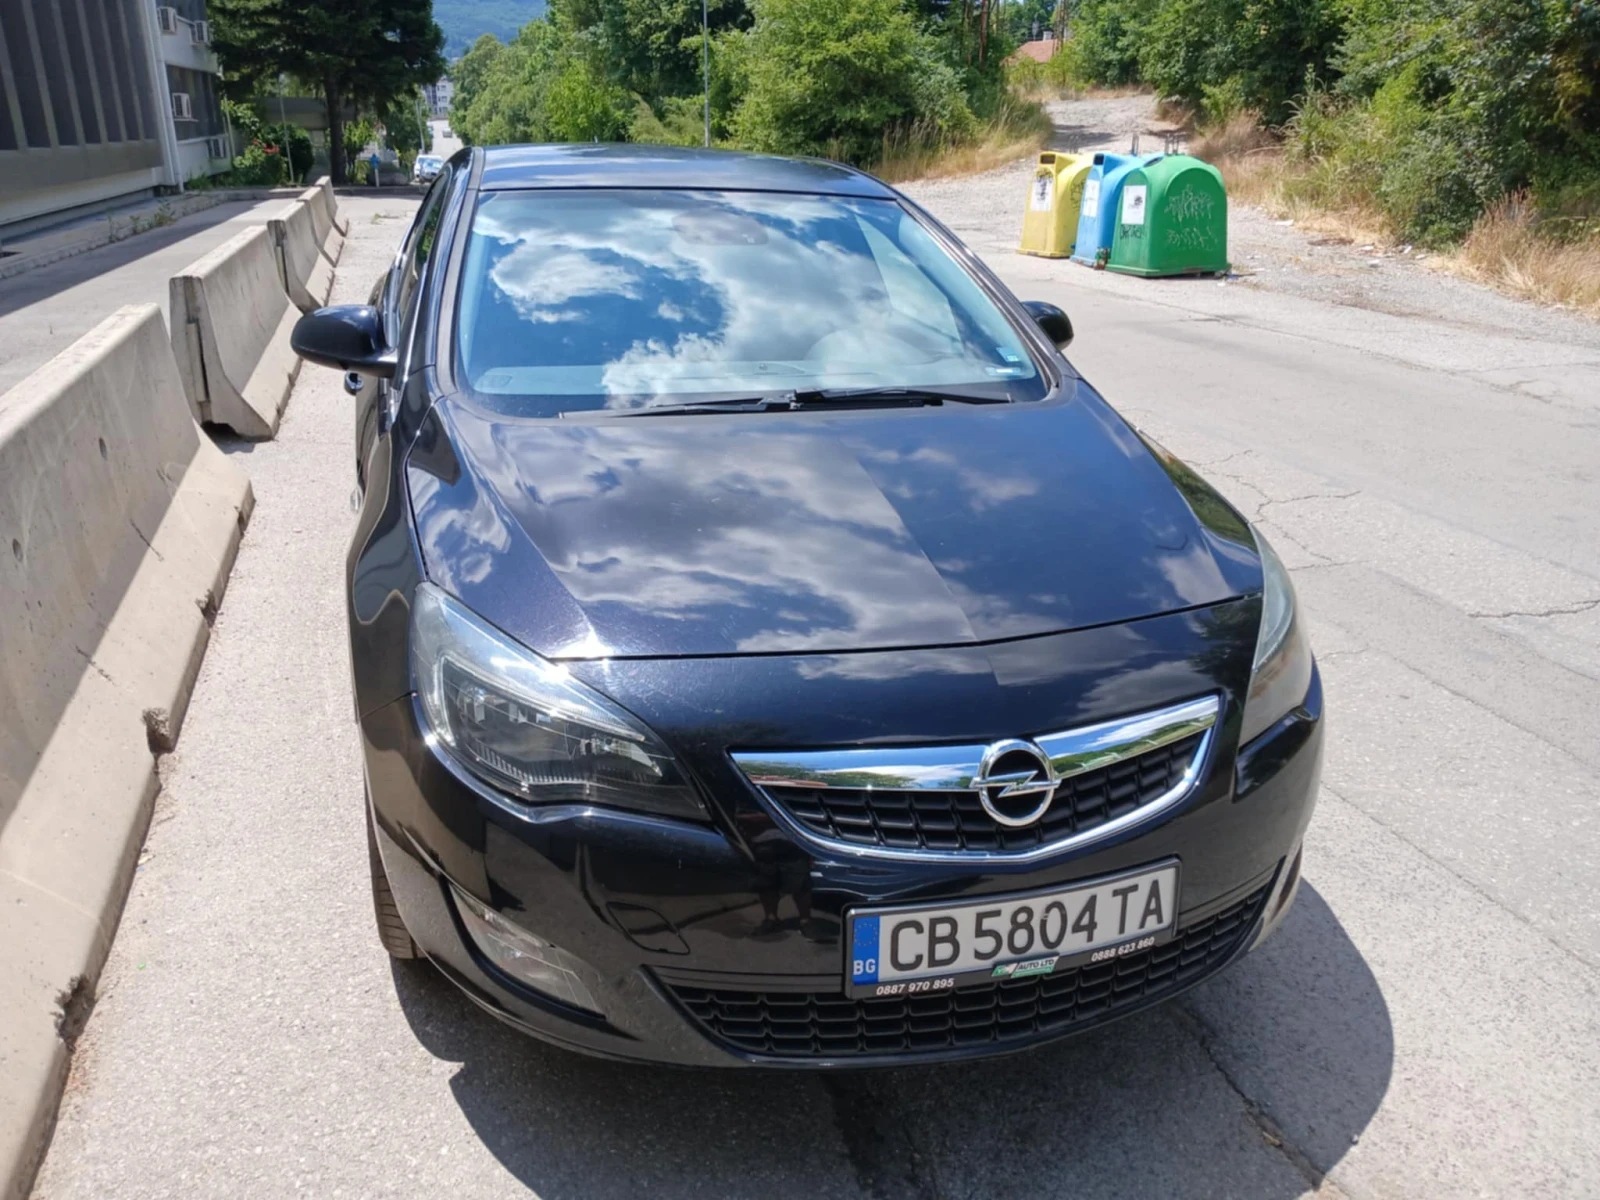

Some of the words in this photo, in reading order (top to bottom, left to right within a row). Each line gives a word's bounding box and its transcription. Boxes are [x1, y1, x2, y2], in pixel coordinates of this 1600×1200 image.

[889, 917, 960, 971] CB
[974, 894, 1098, 961] 5804
[1112, 879, 1164, 934] TA
[1091, 948, 1116, 962] 0888
[1118, 942, 1135, 955] 623
[853, 959, 876, 975] BG
[1018, 961, 1039, 970] AUTO
[1040, 959, 1055, 967] LTD
[876, 984, 905, 996] 0887
[908, 981, 930, 992] 970
[933, 978, 955, 989] 895
